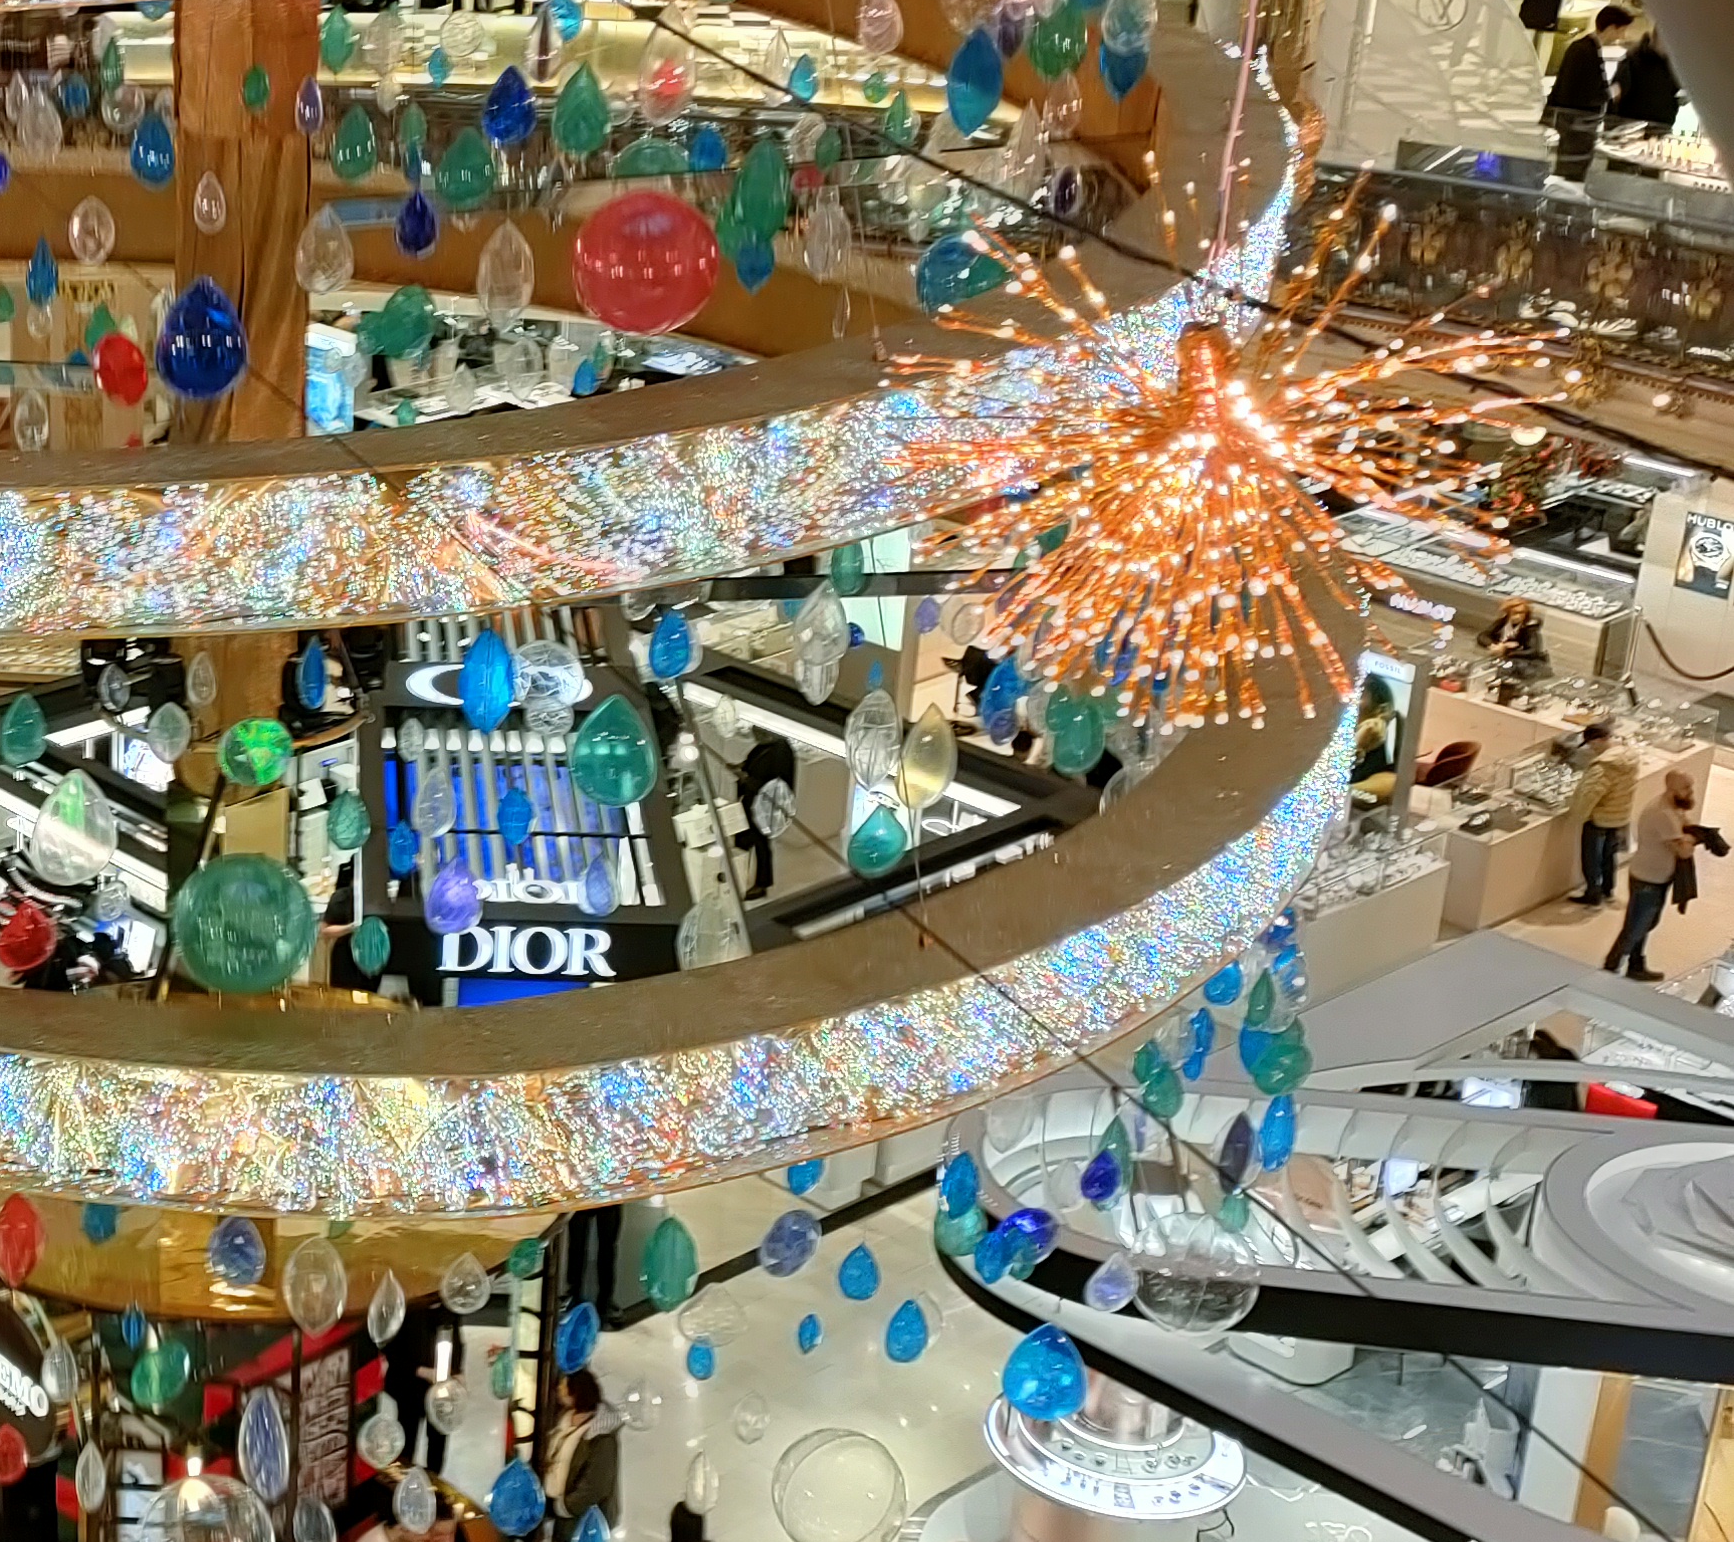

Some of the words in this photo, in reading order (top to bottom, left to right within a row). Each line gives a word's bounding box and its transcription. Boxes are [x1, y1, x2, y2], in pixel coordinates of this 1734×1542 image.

[1686, 512, 1734, 533] HUBLO
[1374, 660, 1402, 675] FOSSIL
[436, 925, 617, 977] DIOR
